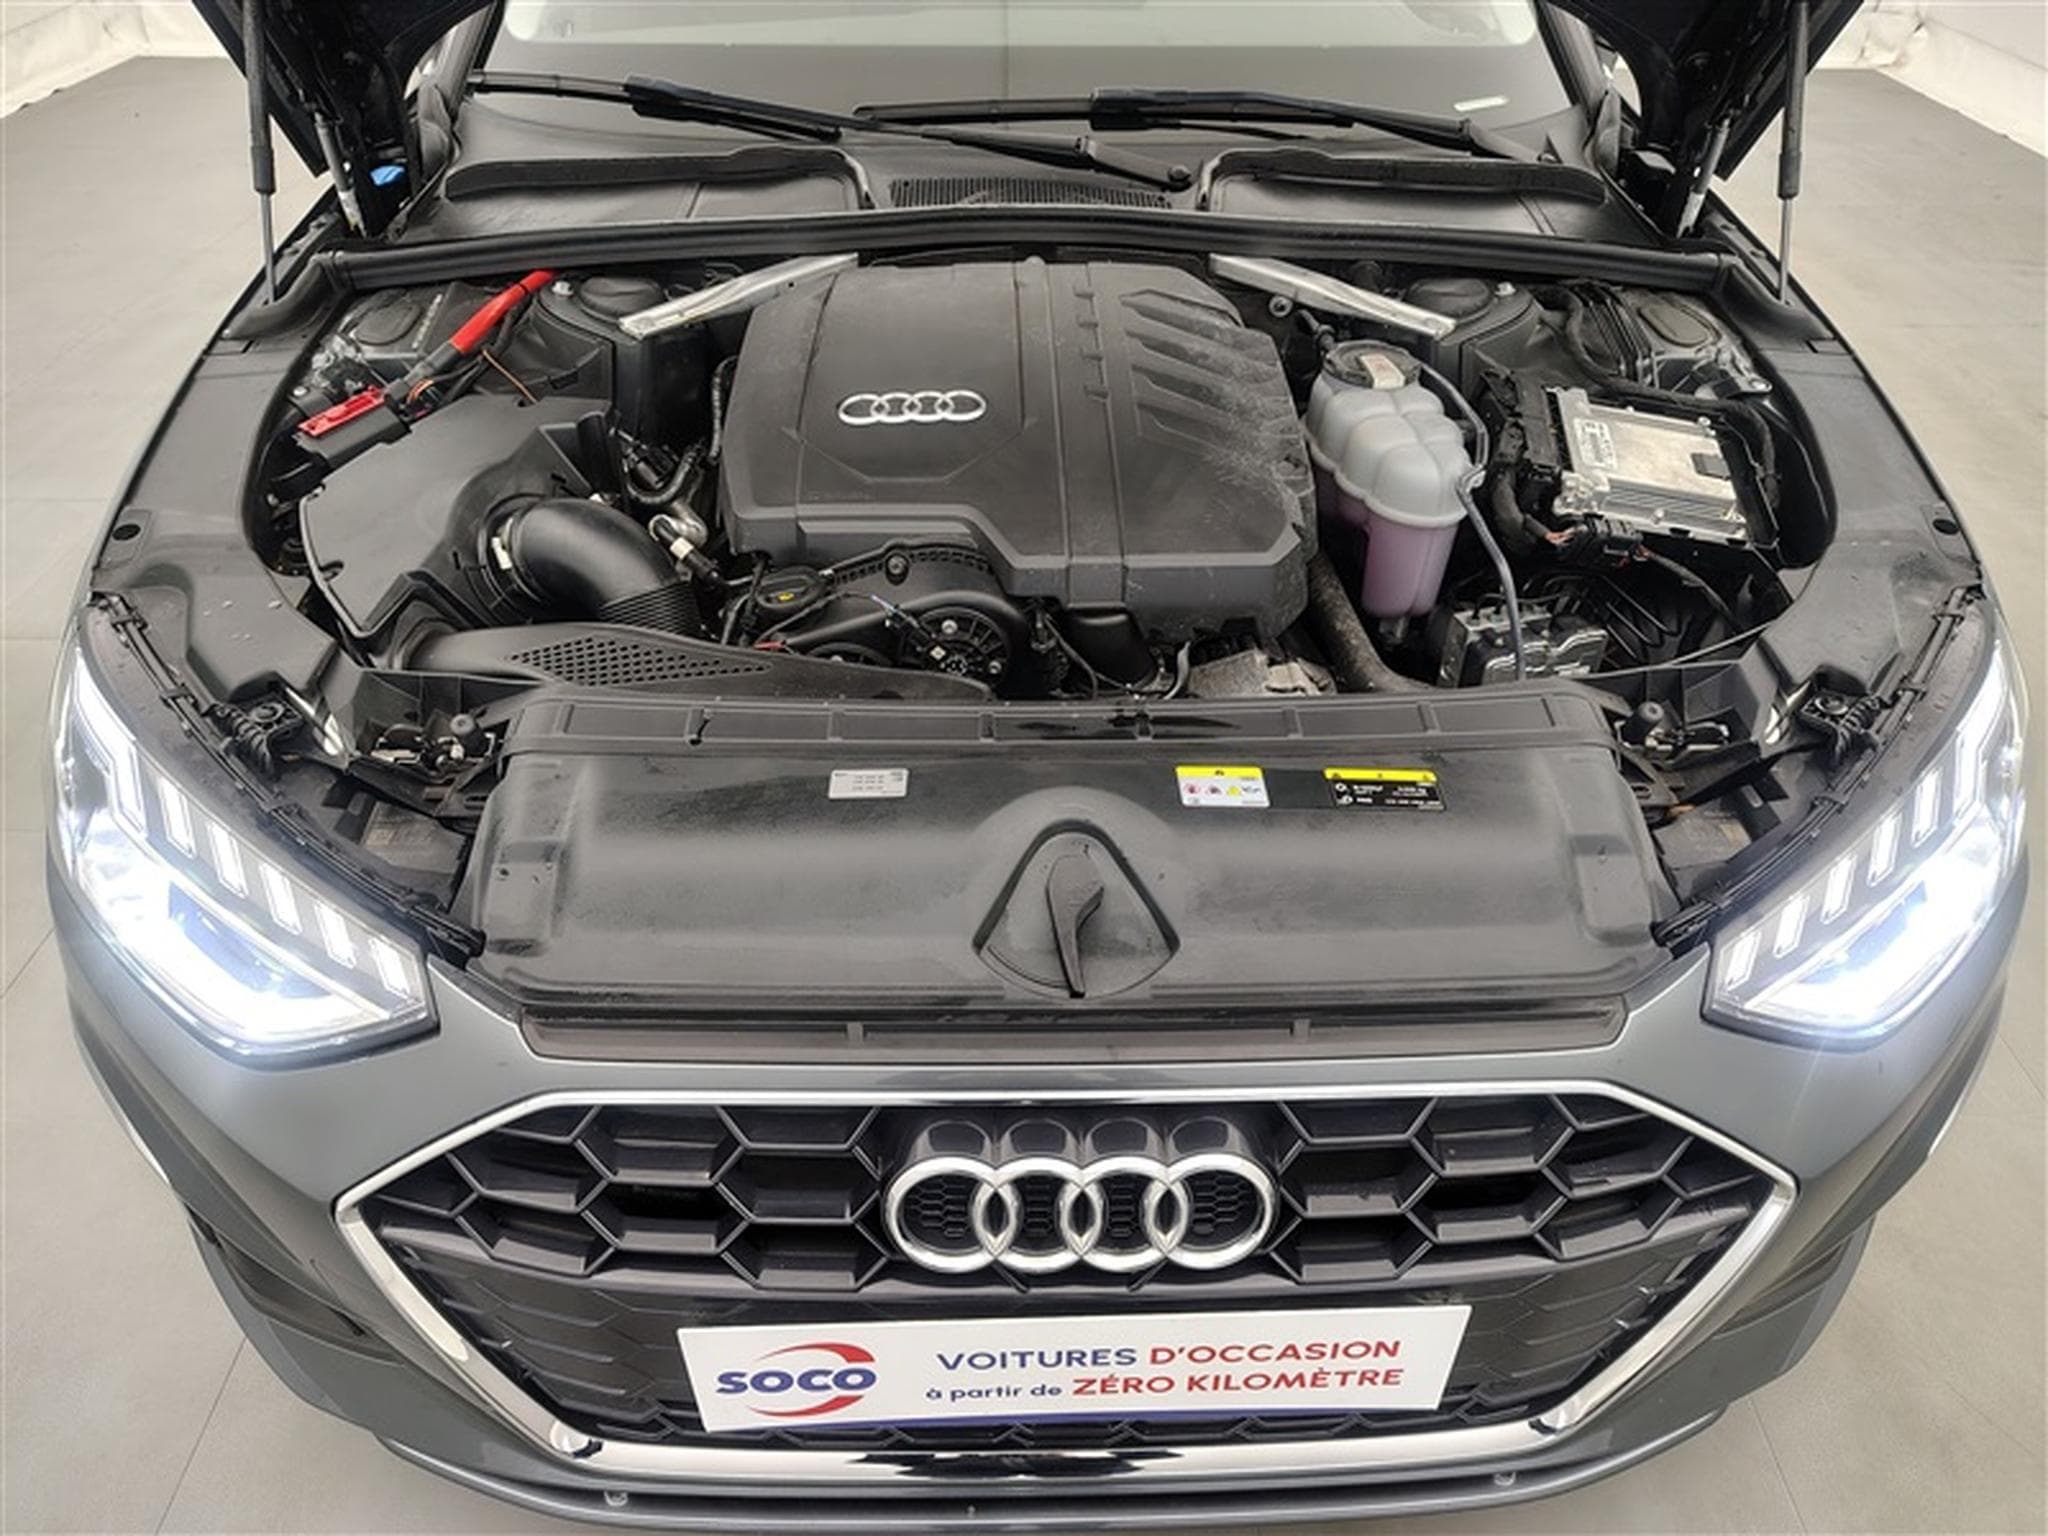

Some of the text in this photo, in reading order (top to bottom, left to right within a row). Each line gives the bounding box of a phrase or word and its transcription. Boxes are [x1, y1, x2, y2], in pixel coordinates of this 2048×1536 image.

[937, 1340, 1401, 1370] VOITURES D'OCCASION
[716, 1367, 877, 1394] SOCO
[925, 1367, 1404, 1402] à partir de ZÉRO KILOMÈTRE
